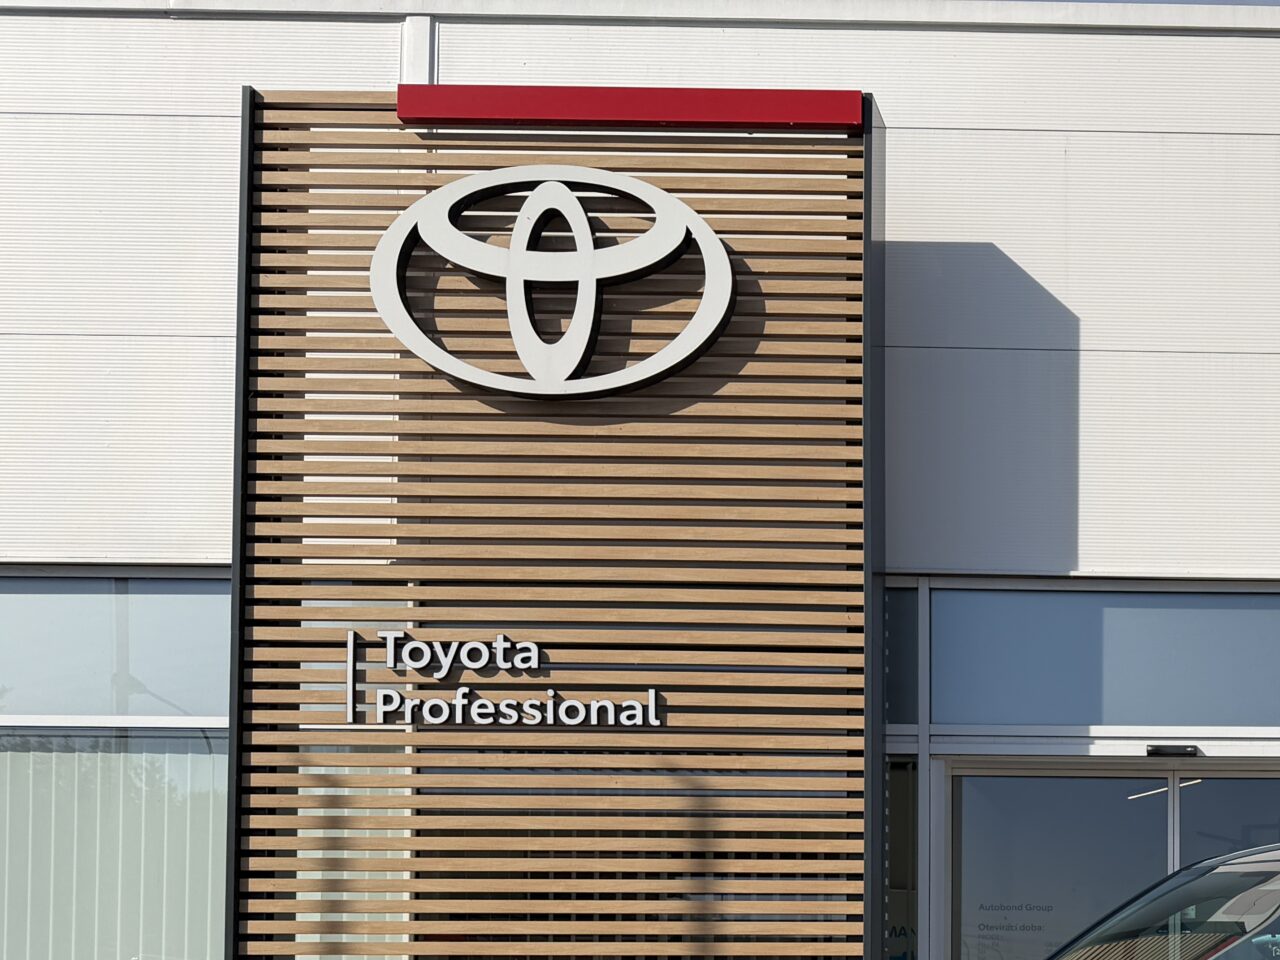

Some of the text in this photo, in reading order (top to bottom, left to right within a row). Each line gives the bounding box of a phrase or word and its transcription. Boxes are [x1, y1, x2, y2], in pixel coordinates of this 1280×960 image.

[377, 630, 540, 679] Toyota
[376, 687, 661, 727] Professional
[978, 903, 1054, 912] Autobond Group
